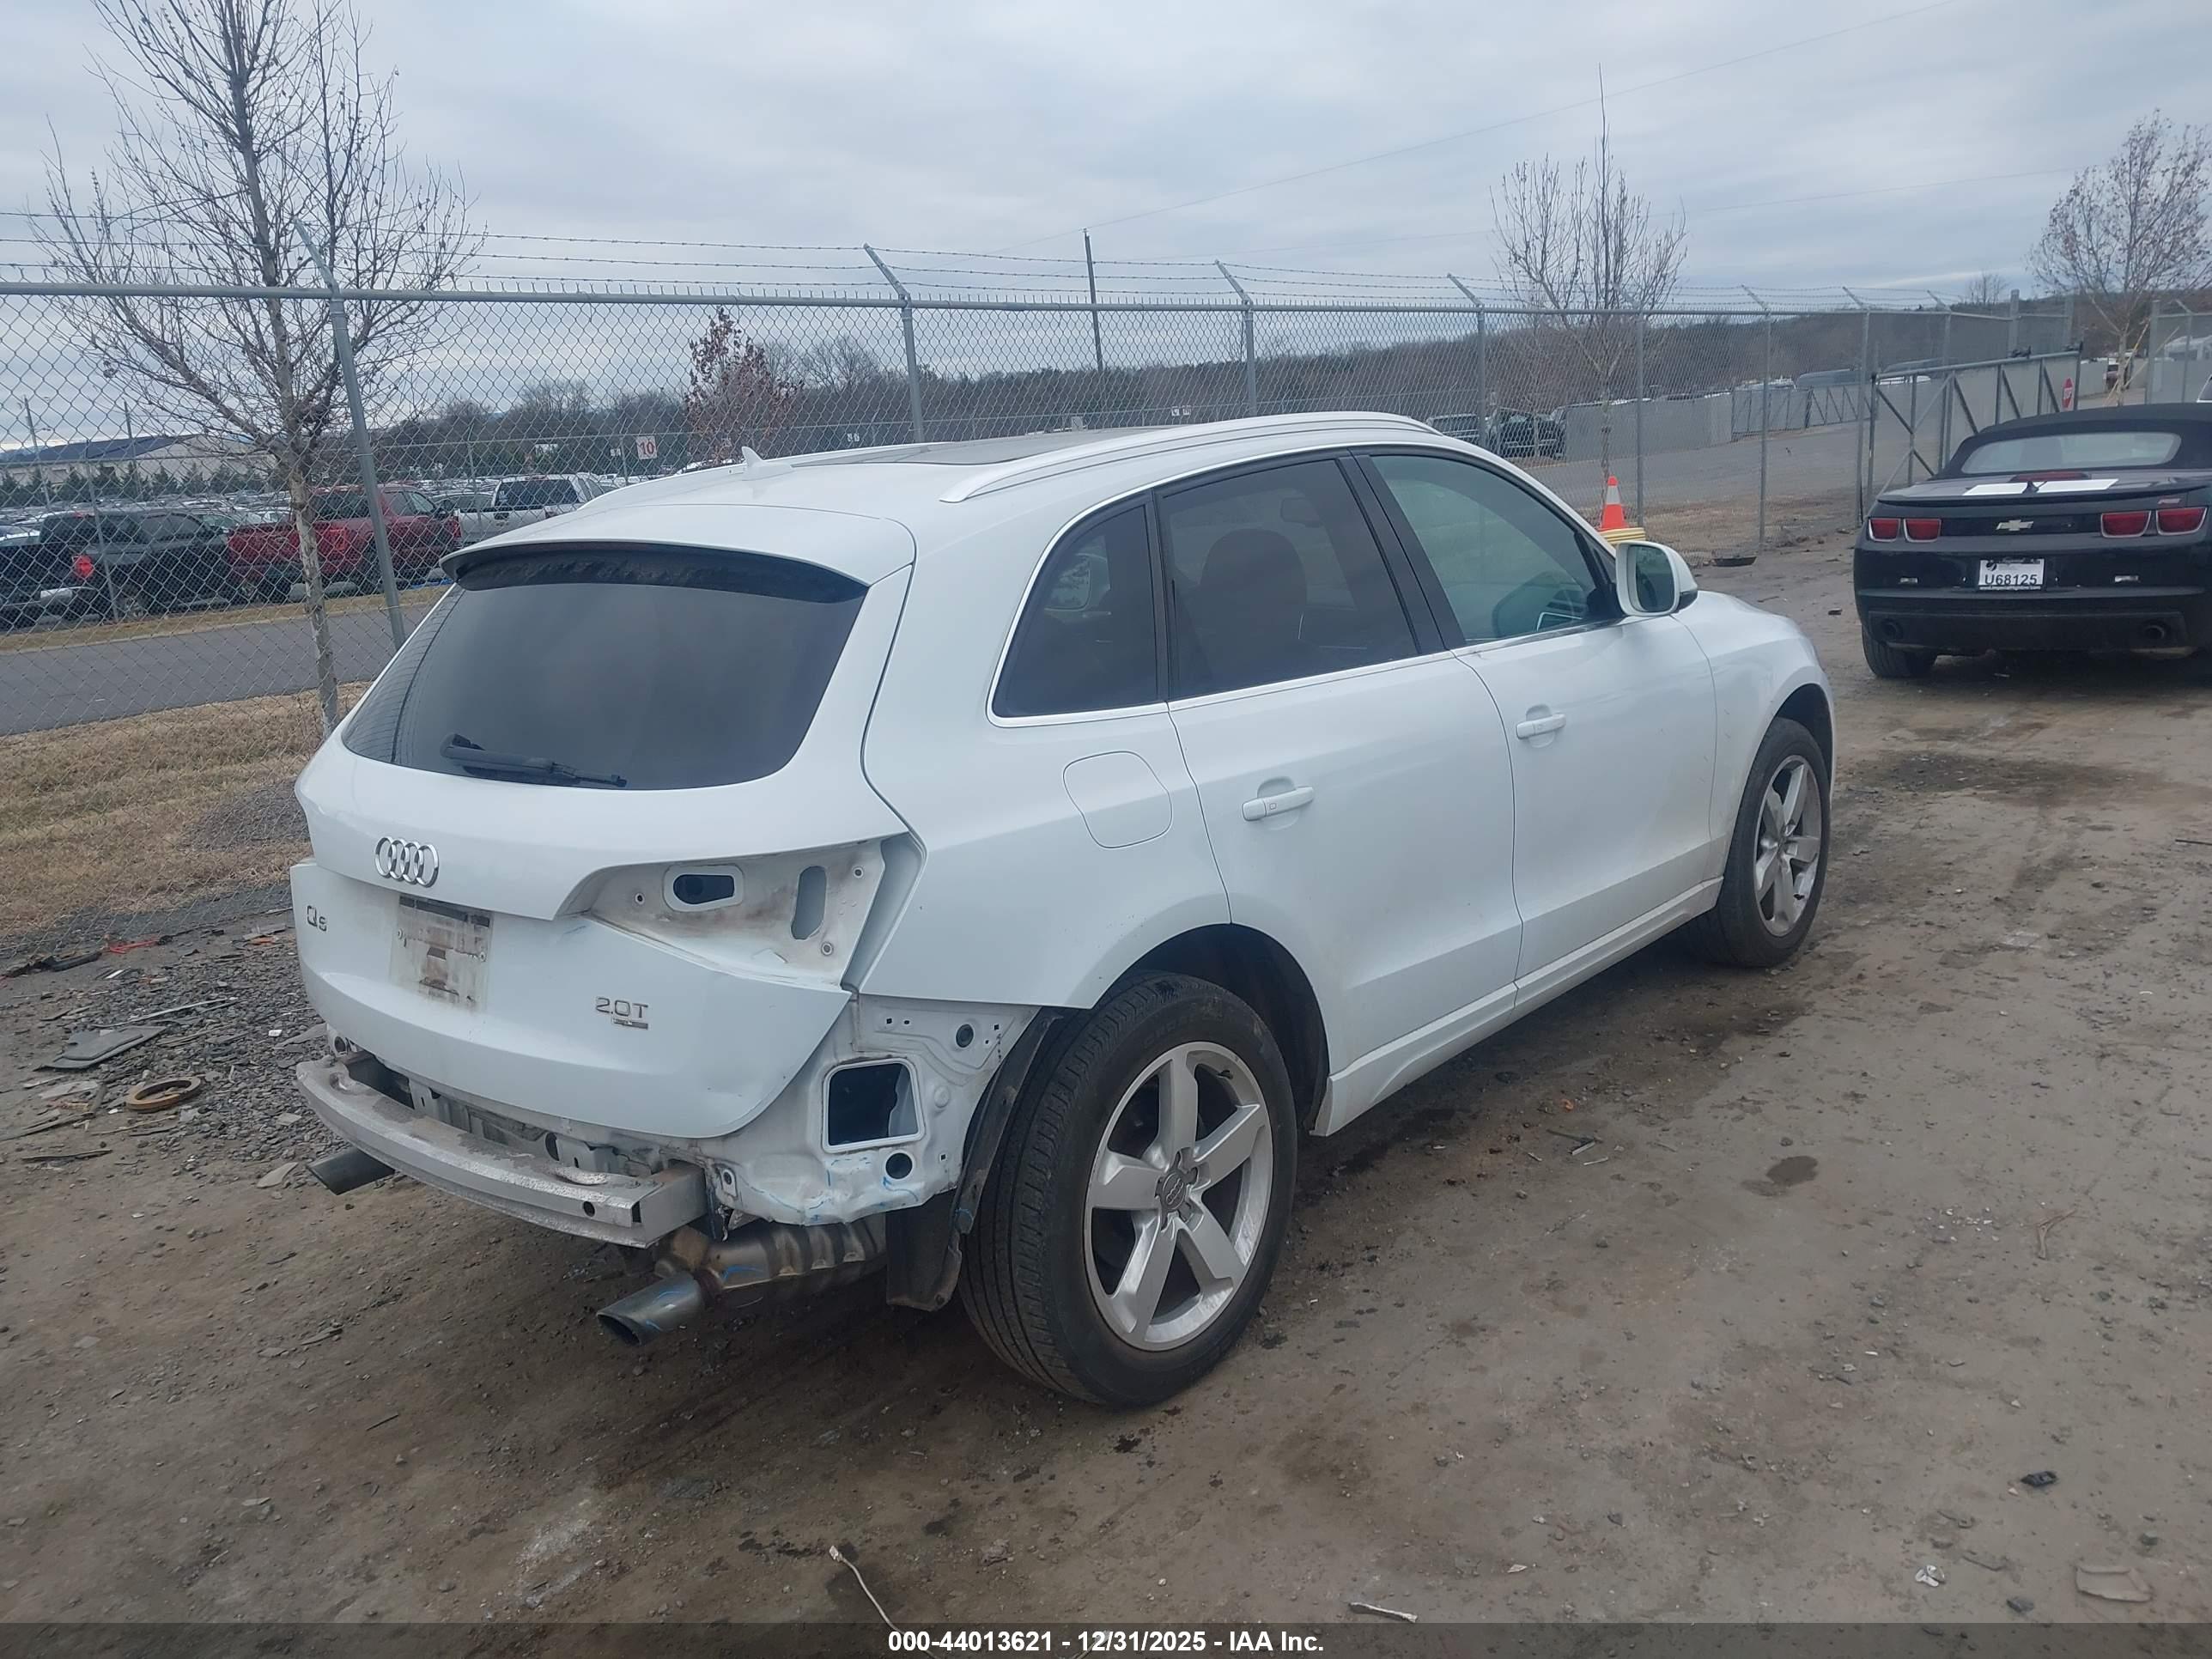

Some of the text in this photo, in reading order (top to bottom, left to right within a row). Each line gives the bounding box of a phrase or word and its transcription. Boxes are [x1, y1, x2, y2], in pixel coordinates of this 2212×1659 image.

[638, 441, 655, 454] 10
[1984, 574, 2038, 586] U68125
[307, 905, 327, 932] Q5
[596, 997, 648, 1018] 2.0T
